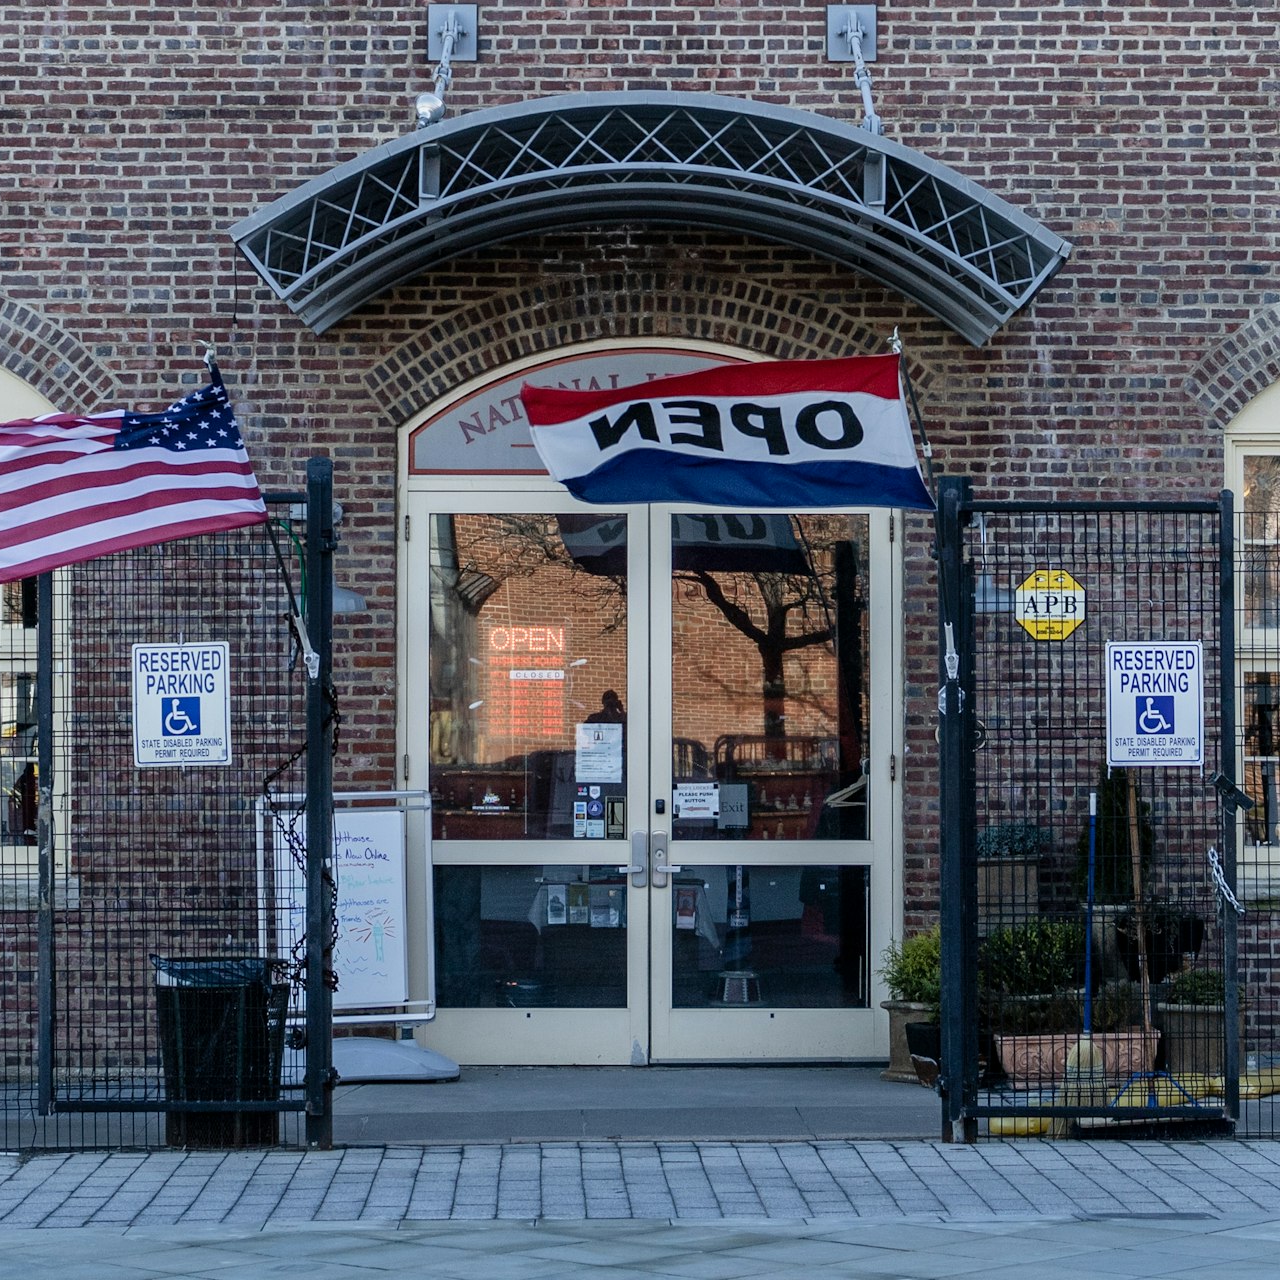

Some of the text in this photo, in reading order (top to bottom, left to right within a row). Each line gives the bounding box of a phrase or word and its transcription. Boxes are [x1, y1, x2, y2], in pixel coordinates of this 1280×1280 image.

[490, 626, 564, 651] OPEN
[140, 650, 221, 672] RESERVED
[1113, 650, 1195, 671] RESERVED
[147, 673, 215, 695] PARKING
[1121, 672, 1189, 693] PARKING
[141, 737, 223, 749] STATE DISABLED PARKING
[1115, 736, 1196, 747] STATE DISABLED PARKING
[155, 748, 210, 758] PERMIT REQUIRED
[1128, 747, 1183, 757] PERMIT REQUIRED
[721, 801, 744, 812] Exit
[345, 848, 363, 859] Now
[365, 847, 390, 861] Online
